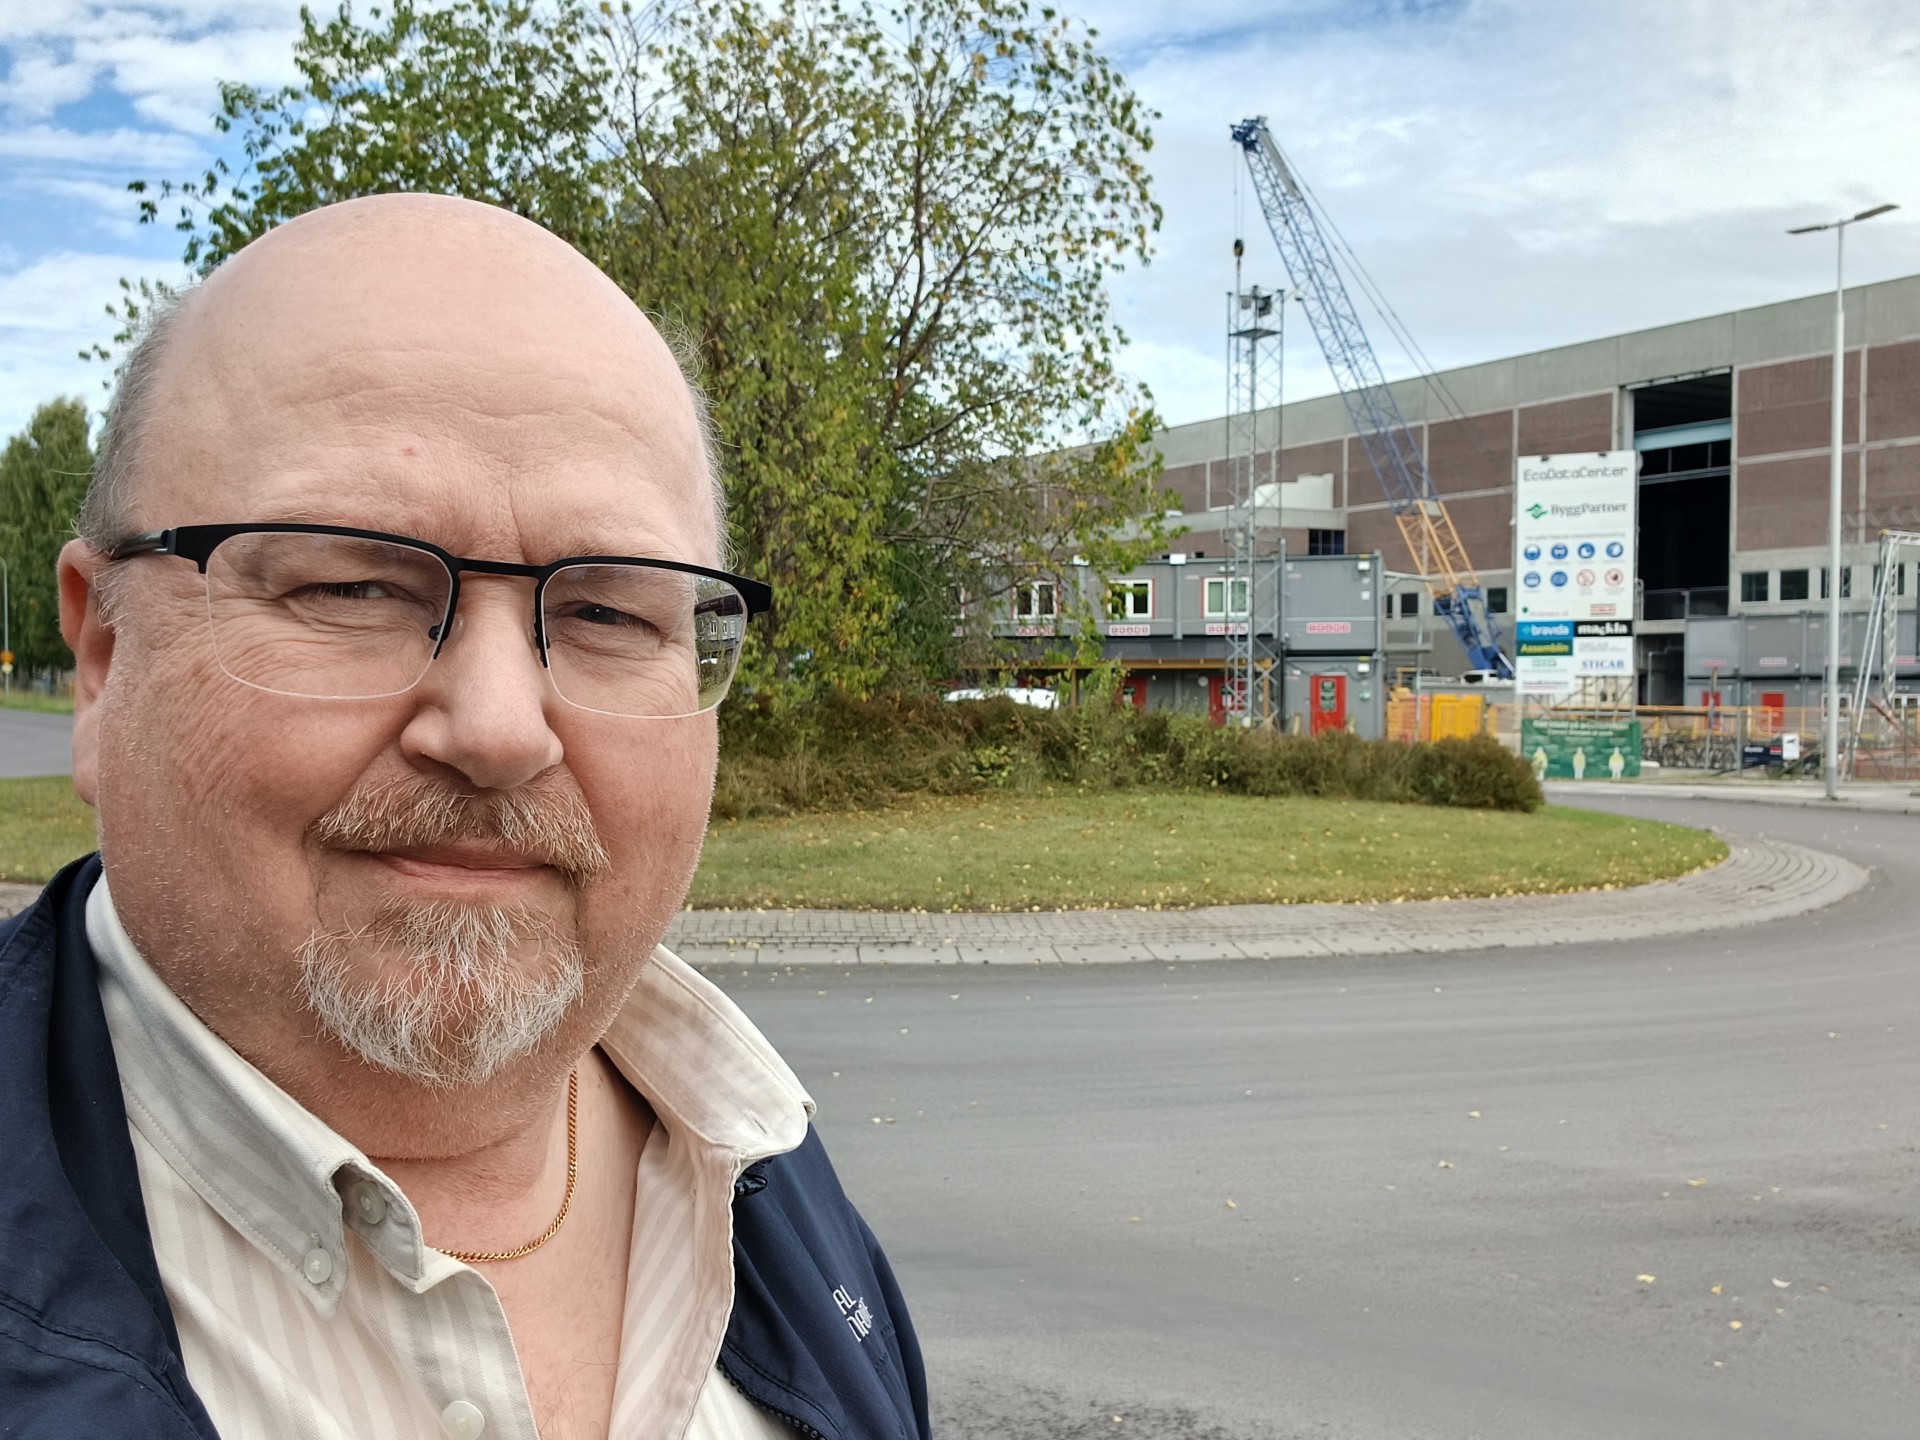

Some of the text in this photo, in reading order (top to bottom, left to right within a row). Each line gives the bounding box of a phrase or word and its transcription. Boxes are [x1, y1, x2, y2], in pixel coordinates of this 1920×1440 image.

[1551, 503, 1628, 517] ByggPartner
[1531, 624, 1570, 636] bravida
[1520, 643, 1569, 654] Assemblin
